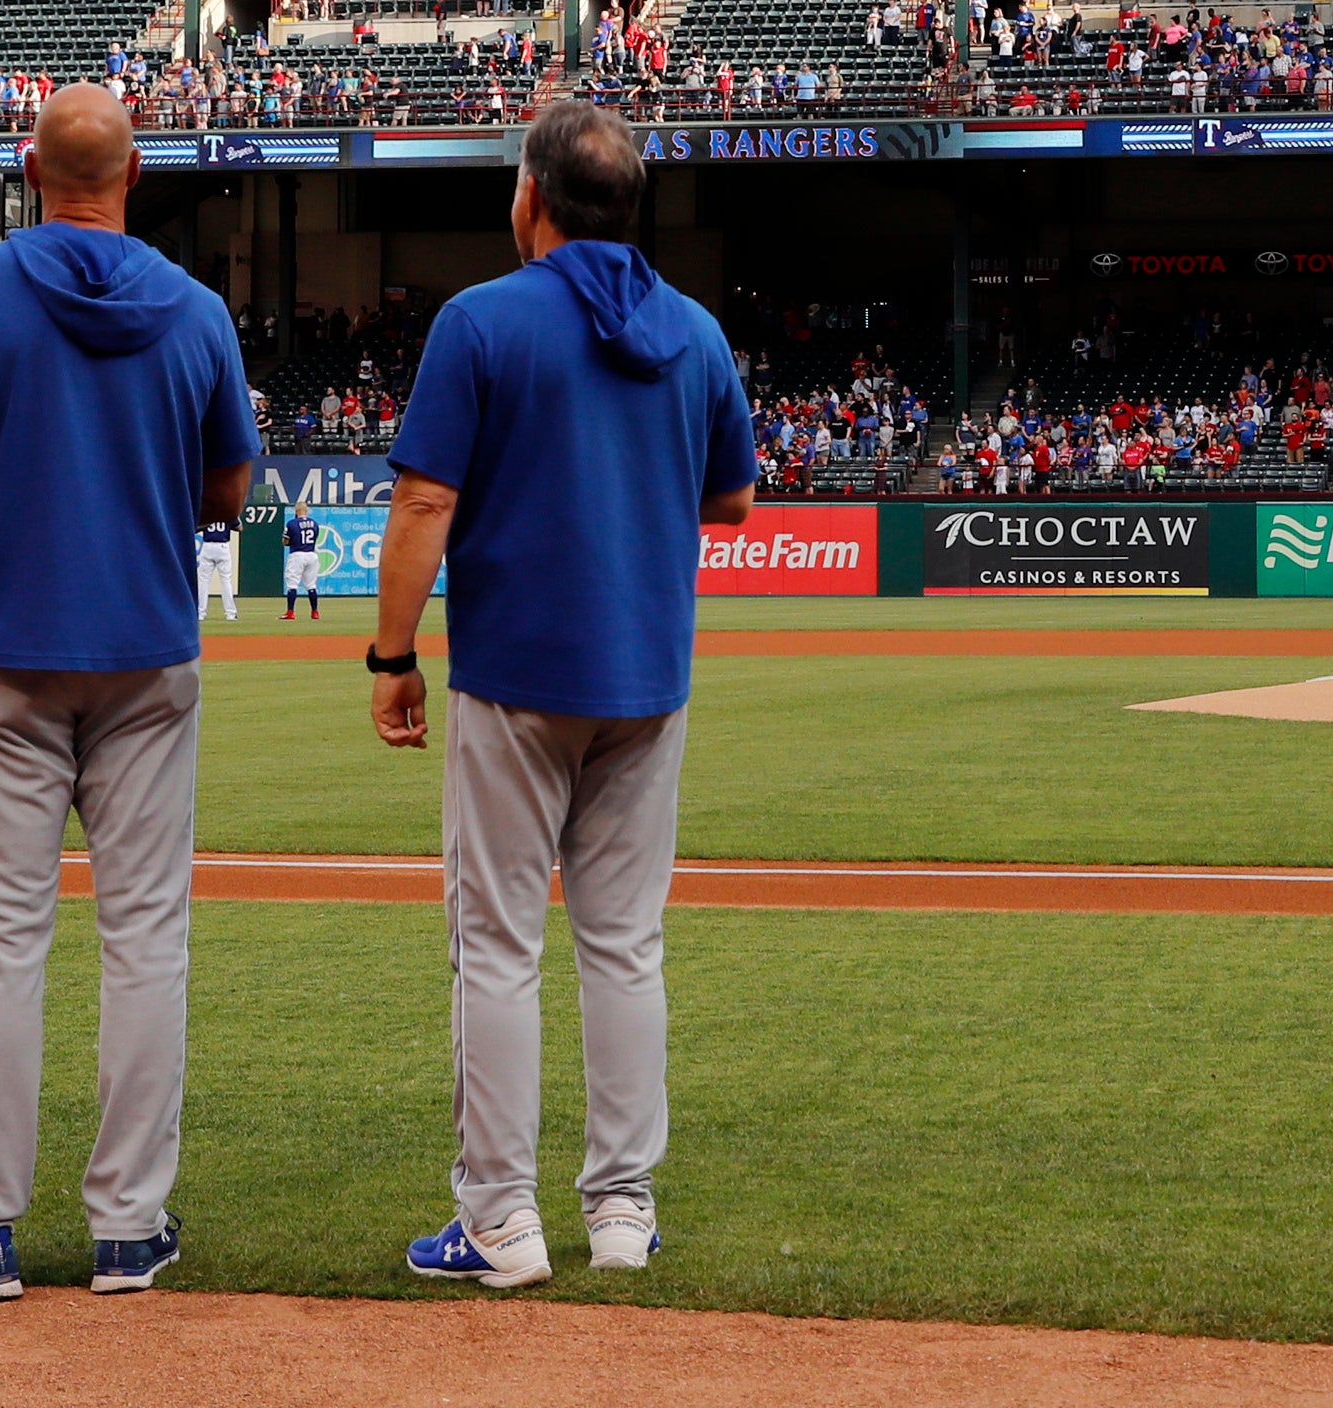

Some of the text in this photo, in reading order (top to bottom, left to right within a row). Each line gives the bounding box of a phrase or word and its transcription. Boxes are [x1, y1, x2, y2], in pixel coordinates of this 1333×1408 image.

[1198, 118, 1222, 148] T
[203, 134, 256, 163] T Rangers
[709, 127, 880, 160] RANGERS
[1127, 255, 1227, 275] TOYOTA
[245, 505, 278, 525] 377
[300, 529, 315, 545] 12
[964, 510, 1198, 548] CHOCTAW
[980, 570, 1181, 586] CASINOS & RESORTS
[496, 1232, 530, 1252] UNDER
